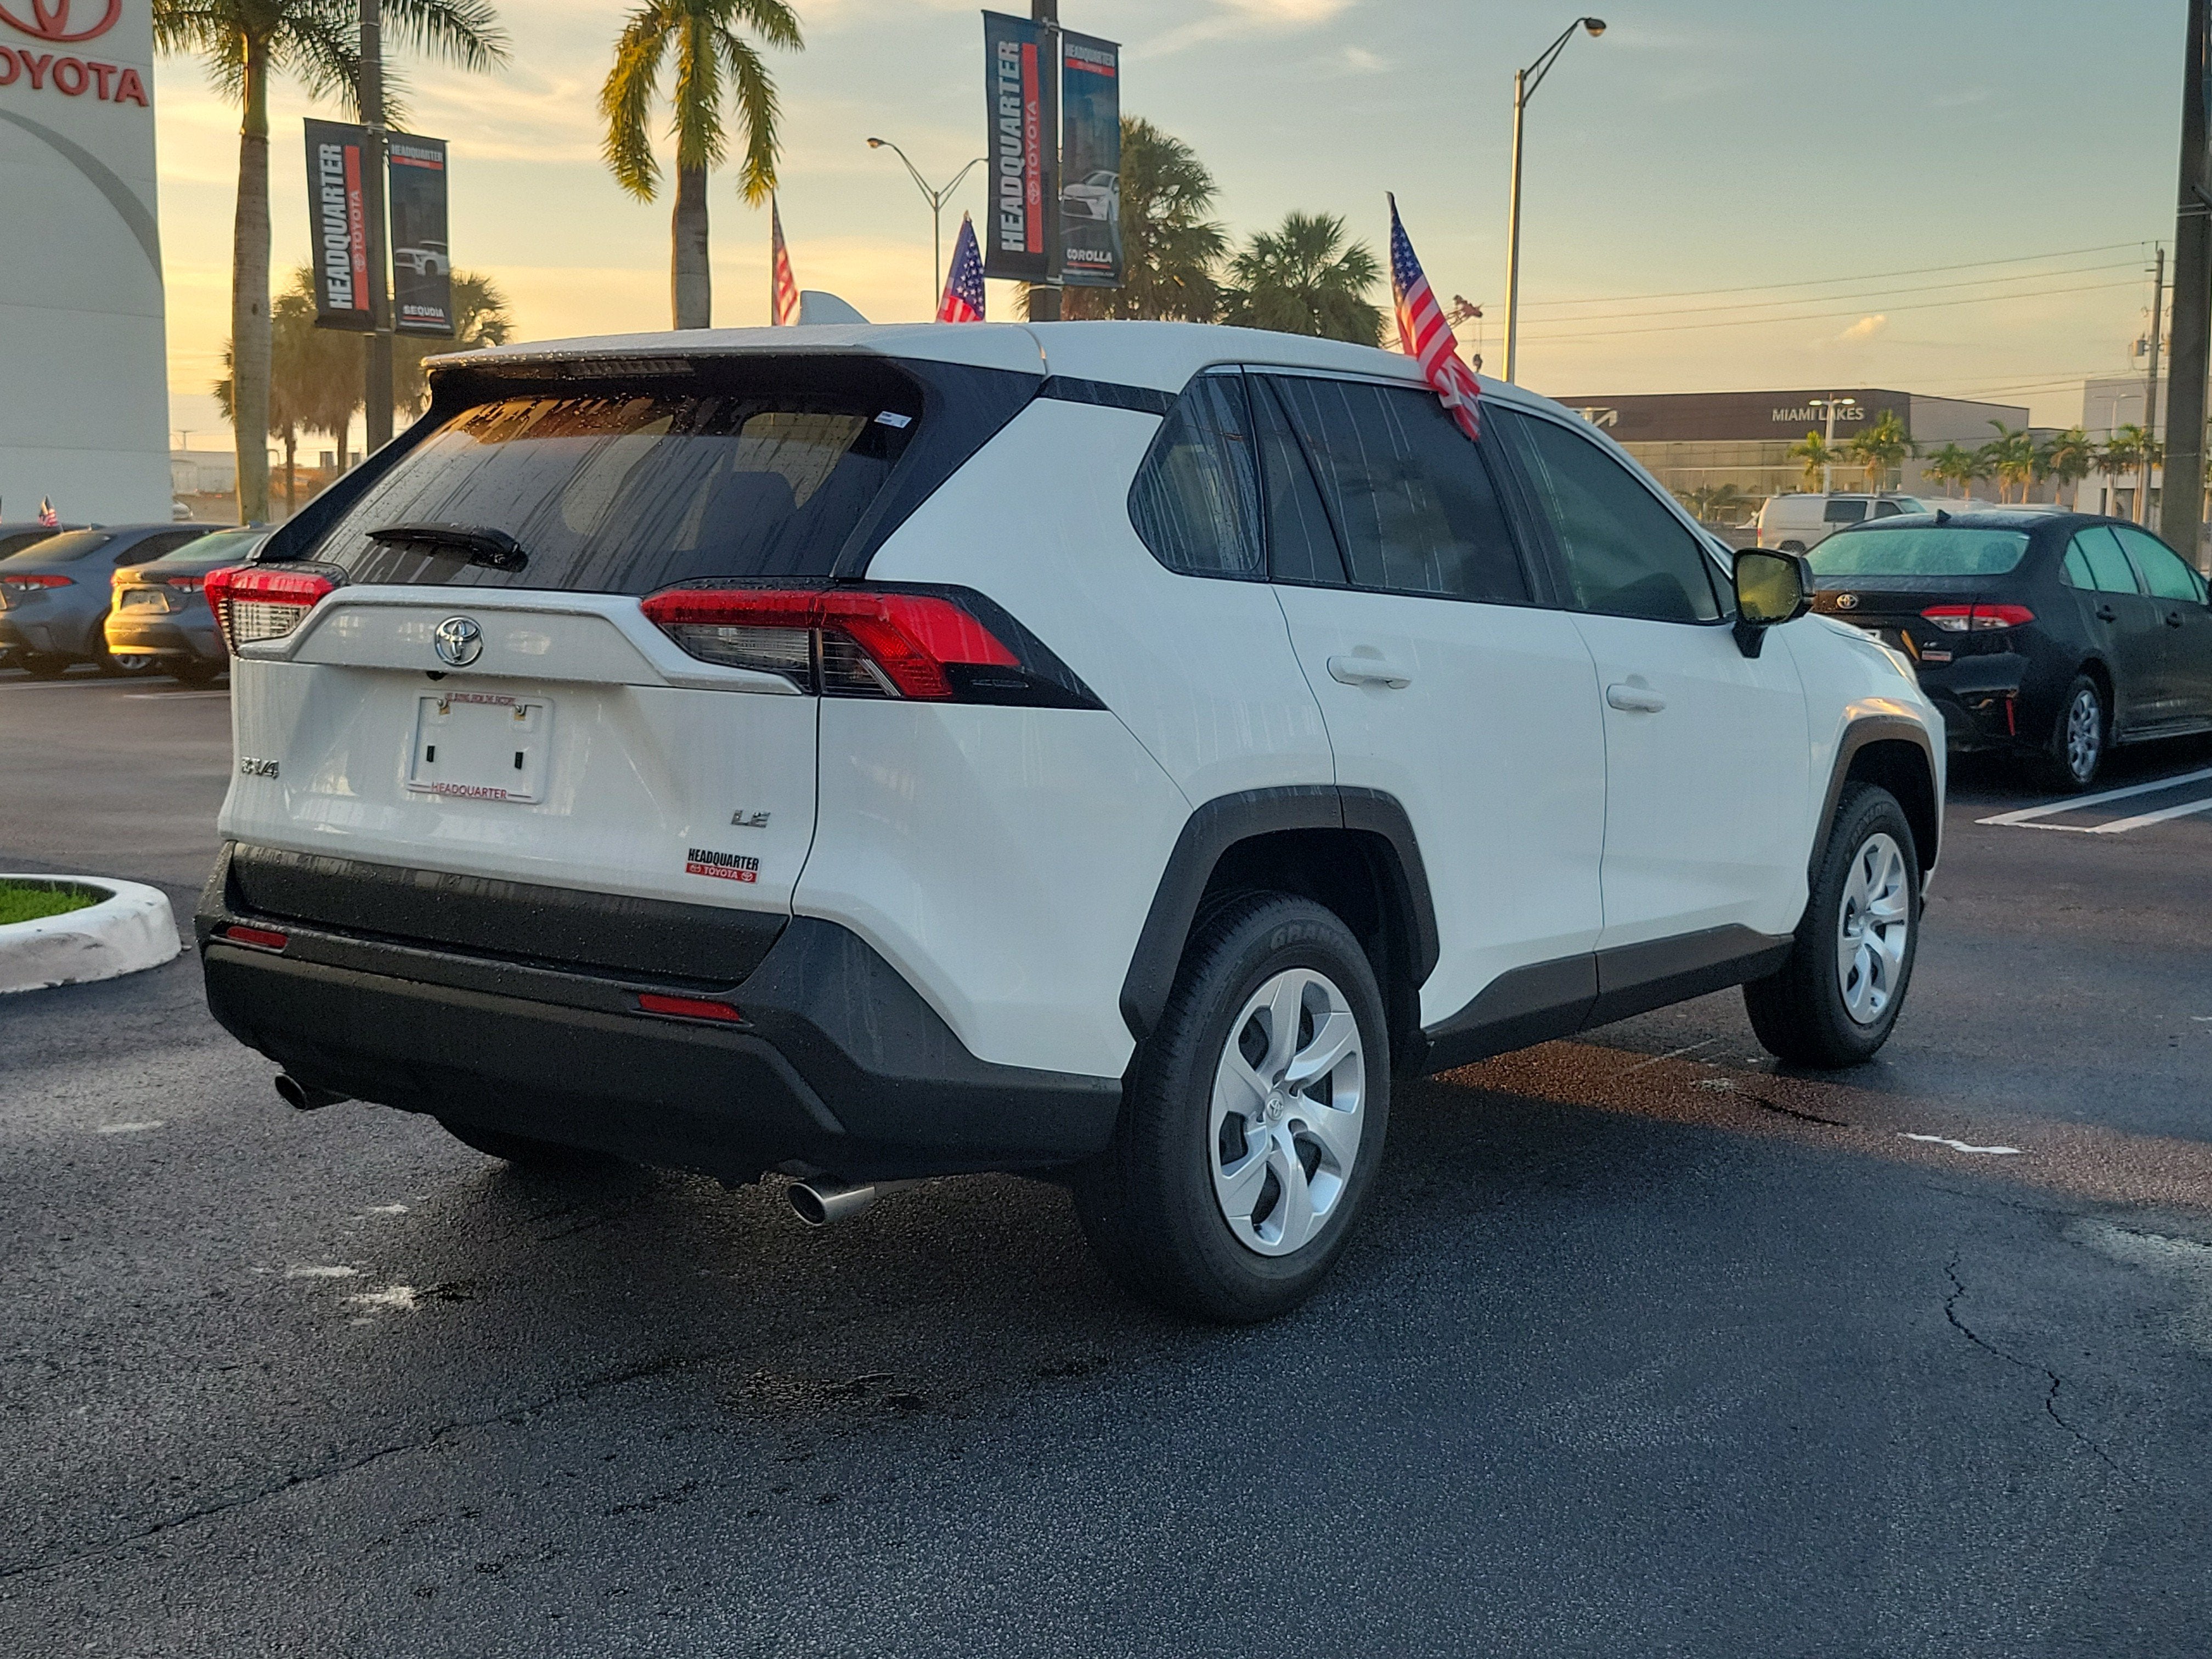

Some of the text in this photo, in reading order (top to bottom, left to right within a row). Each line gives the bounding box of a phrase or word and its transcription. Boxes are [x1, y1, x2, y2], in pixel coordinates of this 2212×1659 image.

[998, 40, 1025, 252] HEADQUARTER
[1026, 100, 1038, 178] TOYOTA
[391, 144, 443, 162] HEADQUARTER
[320, 143, 353, 309] HEADQUARTER
[351, 190, 363, 250] TOYOTA
[1066, 248, 1112, 263] COROLLA
[403, 304, 445, 318] SEQUOIA
[1772, 407, 1815, 421] MIAMI
[431, 781, 507, 799] HEADQUARTER
[731, 809, 771, 828] LE
[687, 848, 759, 871] HEADQUARTER
[704, 866, 738, 879] TOYOTA
